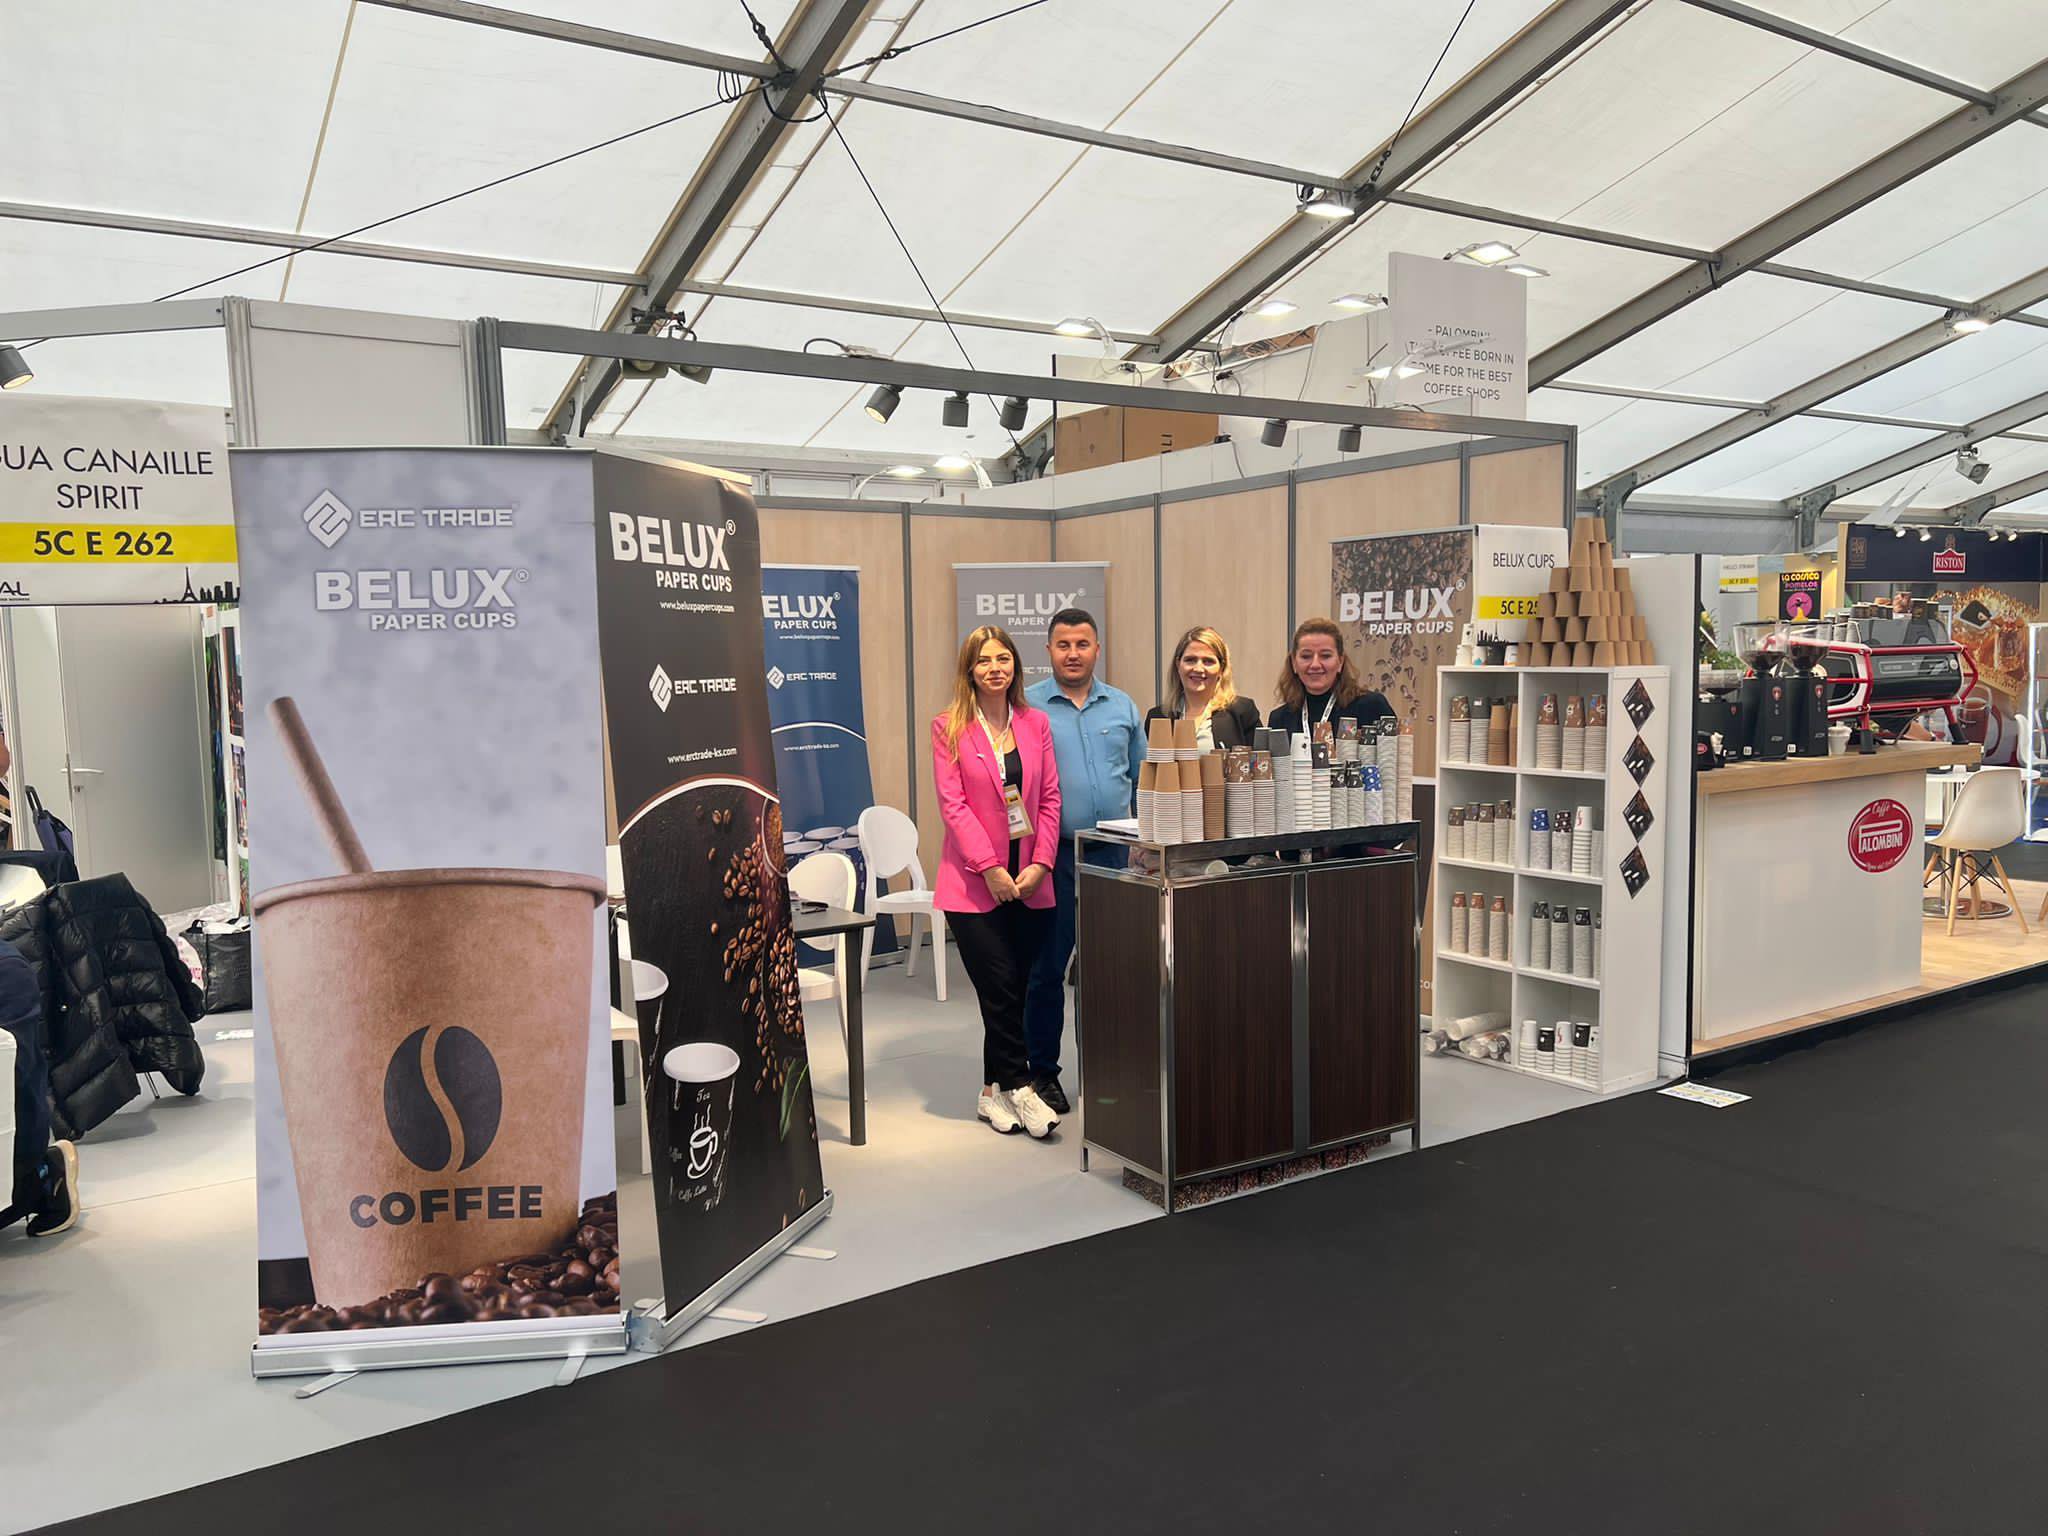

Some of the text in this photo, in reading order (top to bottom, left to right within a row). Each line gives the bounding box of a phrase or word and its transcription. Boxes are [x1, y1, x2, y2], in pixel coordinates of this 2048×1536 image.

[1473, 349, 1502, 363] BORN
[1504, 353, 1514, 365] IN
[1443, 365, 1464, 377] FOR
[1466, 367, 1486, 380] THE
[1488, 370, 1513, 382] BEST
[1423, 382, 1501, 401] COFFEE SHOPS
[0, 445, 214, 475] UA CANAILLE
[57, 483, 144, 510] SPIRIT
[359, 508, 513, 528] ERC TRADE
[33, 530, 175, 556] 5C E 262
[1492, 552, 1556, 569] BELUX CUPS
[1935, 557, 1964, 569] RISTON
[656, 570, 733, 593] PAPER CUPS
[1500, 600, 1515, 615] 5C
[1517, 600, 1524, 615] E
[370, 612, 517, 630] PAPER CUPS
[773, 619, 838, 631] PAPER CUPS
[1007, 616, 1045, 626] PAPER
[1368, 620, 1455, 636] PAPER CUPS
[786, 671, 838, 681] ERC TRADE
[674, 677, 737, 695] ERC TRADE
[666, 747, 738, 763] www.erctrade-ks.com
[350, 1185, 543, 1229] COFFEE
